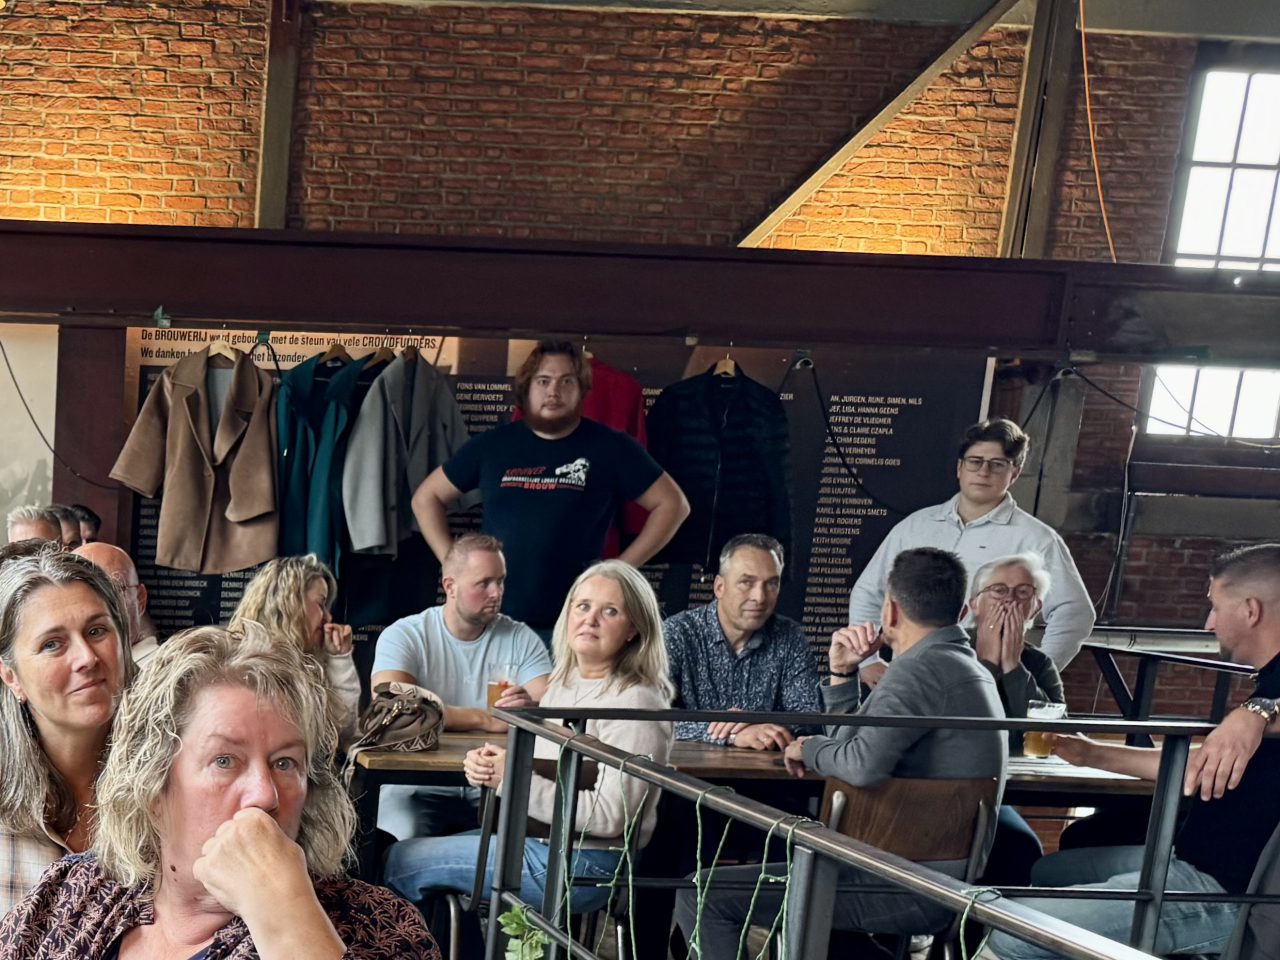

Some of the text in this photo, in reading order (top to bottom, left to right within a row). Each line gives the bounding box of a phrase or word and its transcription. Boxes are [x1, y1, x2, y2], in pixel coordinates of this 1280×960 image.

[142, 329, 152, 341] De
[154, 330, 208, 342] BROUWERIJ
[232, 334, 257, 346] gebou
[271, 336, 287, 344] met
[289, 335, 299, 345] de
[301, 336, 324, 346] steun
[344, 336, 360, 346] vele
[140, 348, 153, 358] We
[155, 348, 185, 360] danken
[825, 436, 852, 444] JCHIM
[824, 446, 844, 454] JOHN
[823, 456, 854, 464] JOHANES
